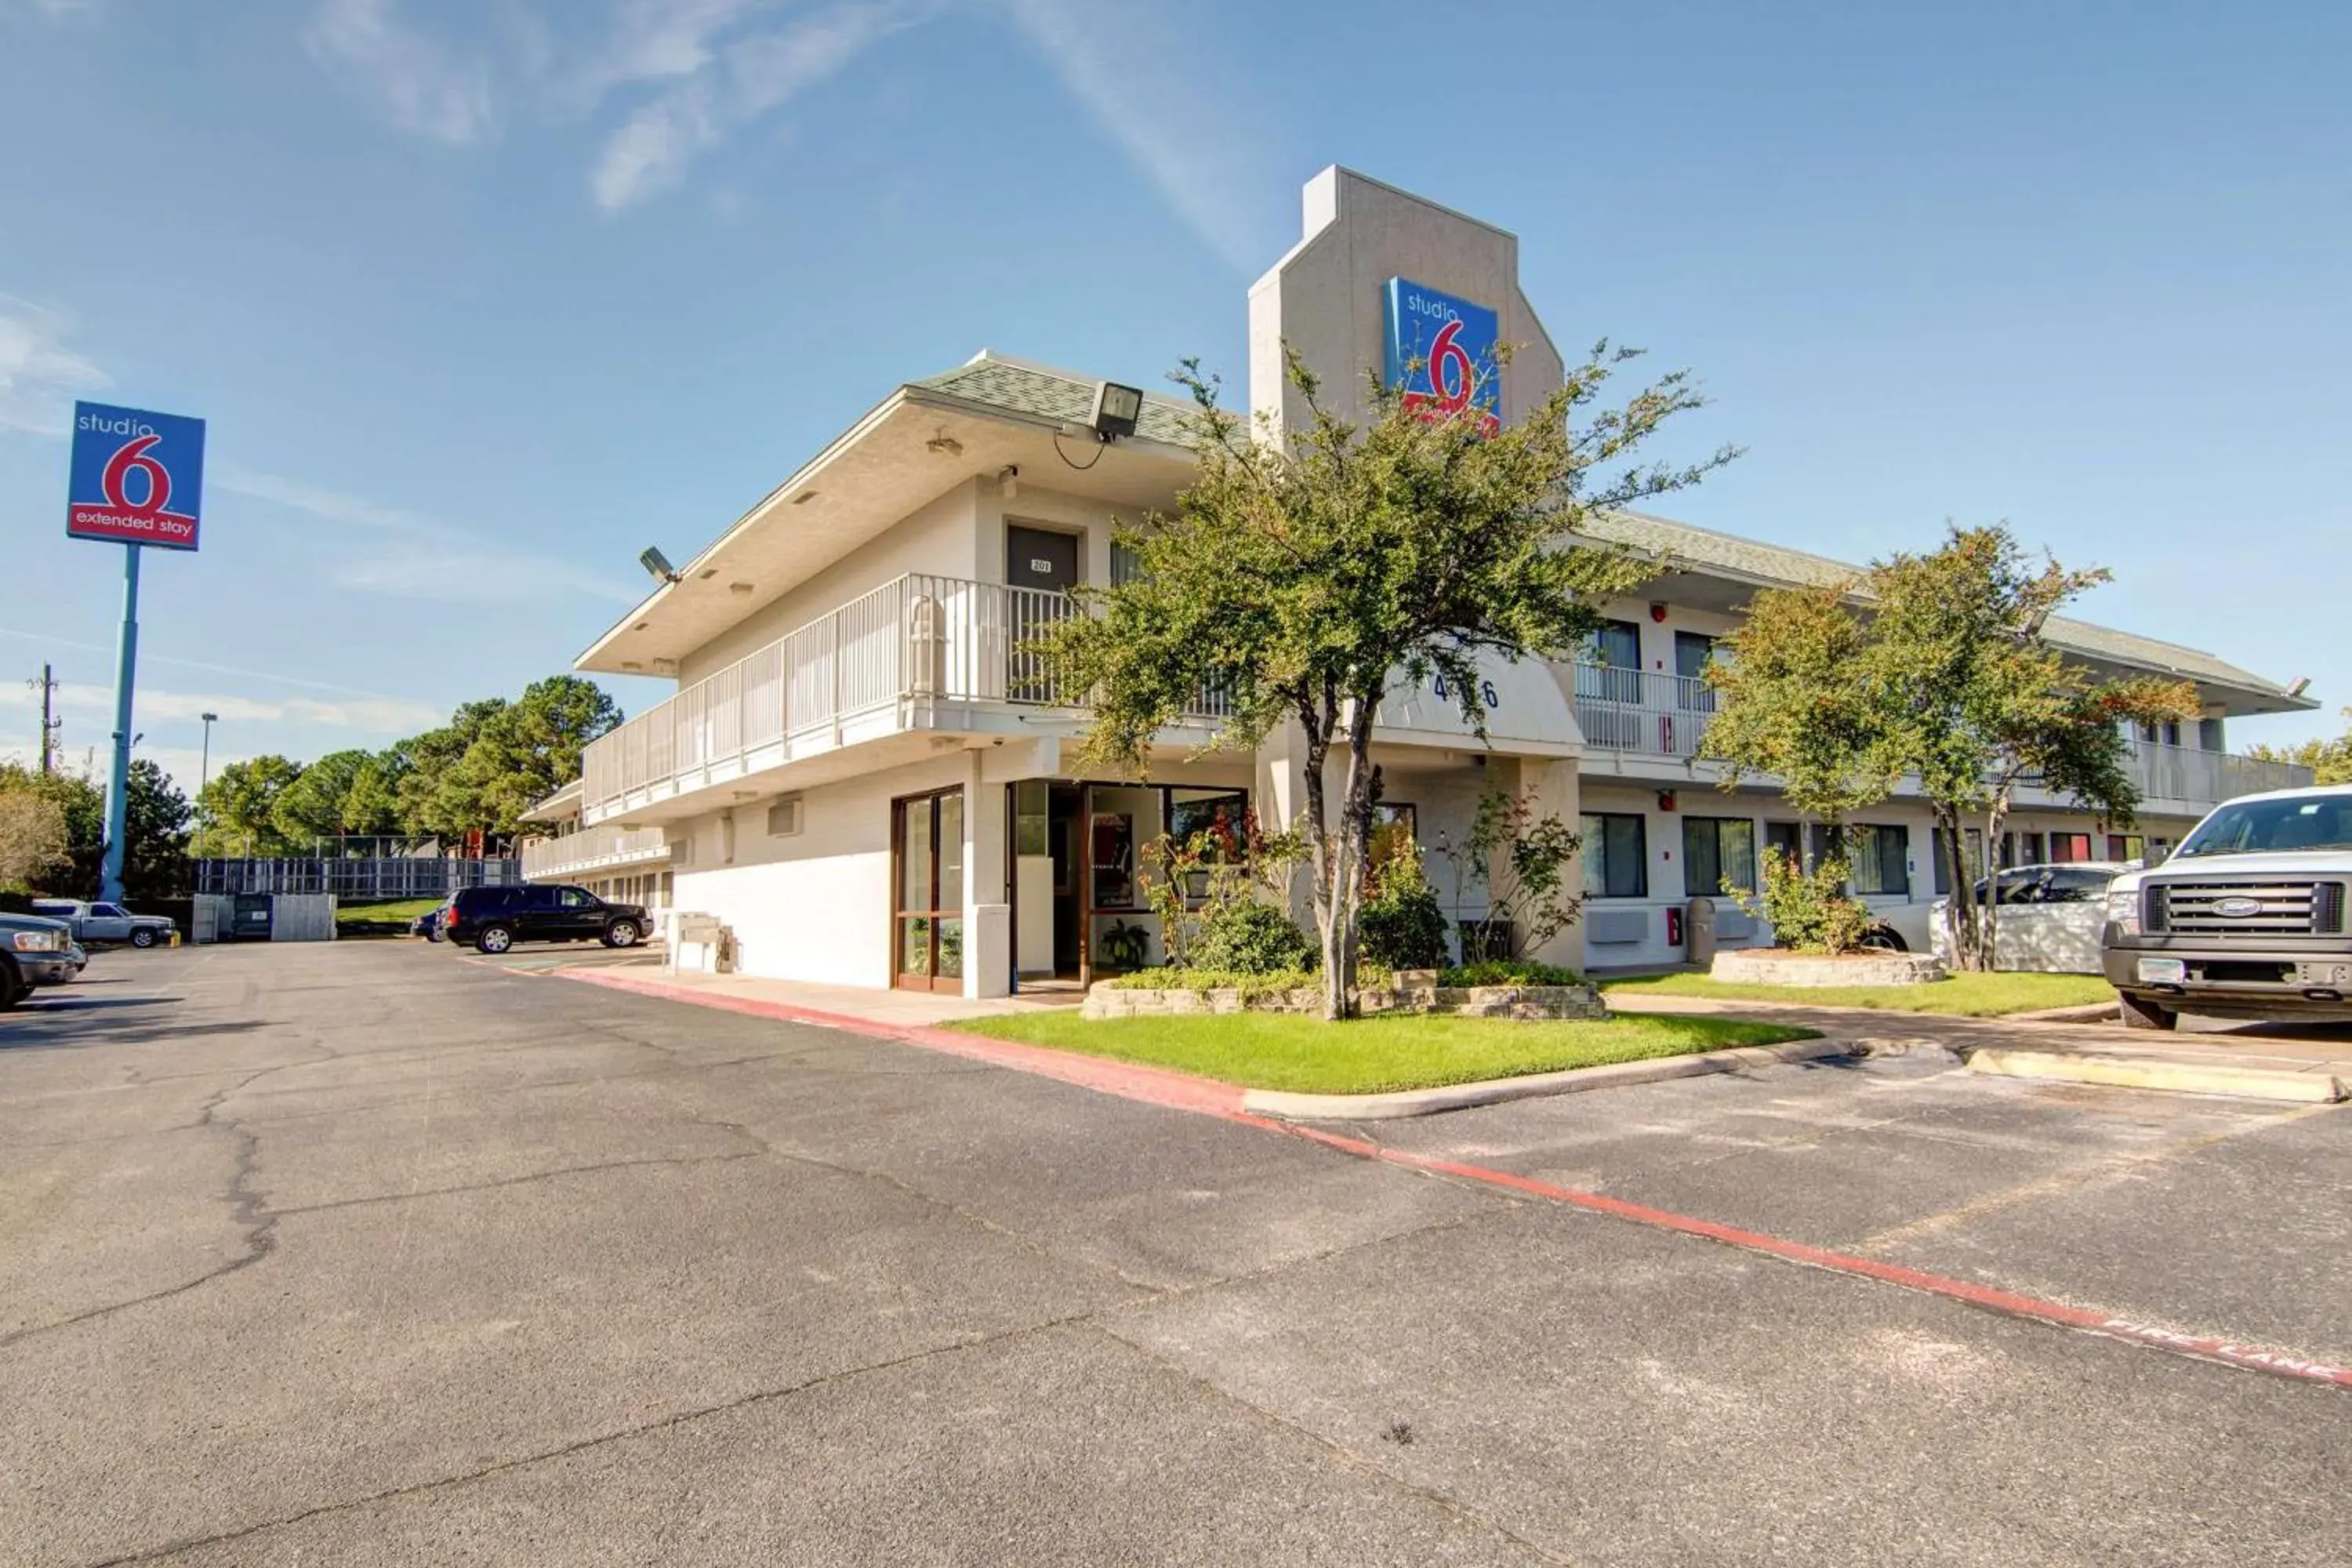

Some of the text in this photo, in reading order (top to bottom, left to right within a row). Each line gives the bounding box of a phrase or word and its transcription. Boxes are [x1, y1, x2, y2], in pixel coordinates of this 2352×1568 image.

[1408, 292, 1458, 322] studio
[1428, 320, 1475, 408] 6
[78, 413, 154, 437] studio
[101, 434, 172, 512] 6
[76, 511, 192, 537] extended stay
[2103, 1319, 2341, 1378] FIRE LANE
